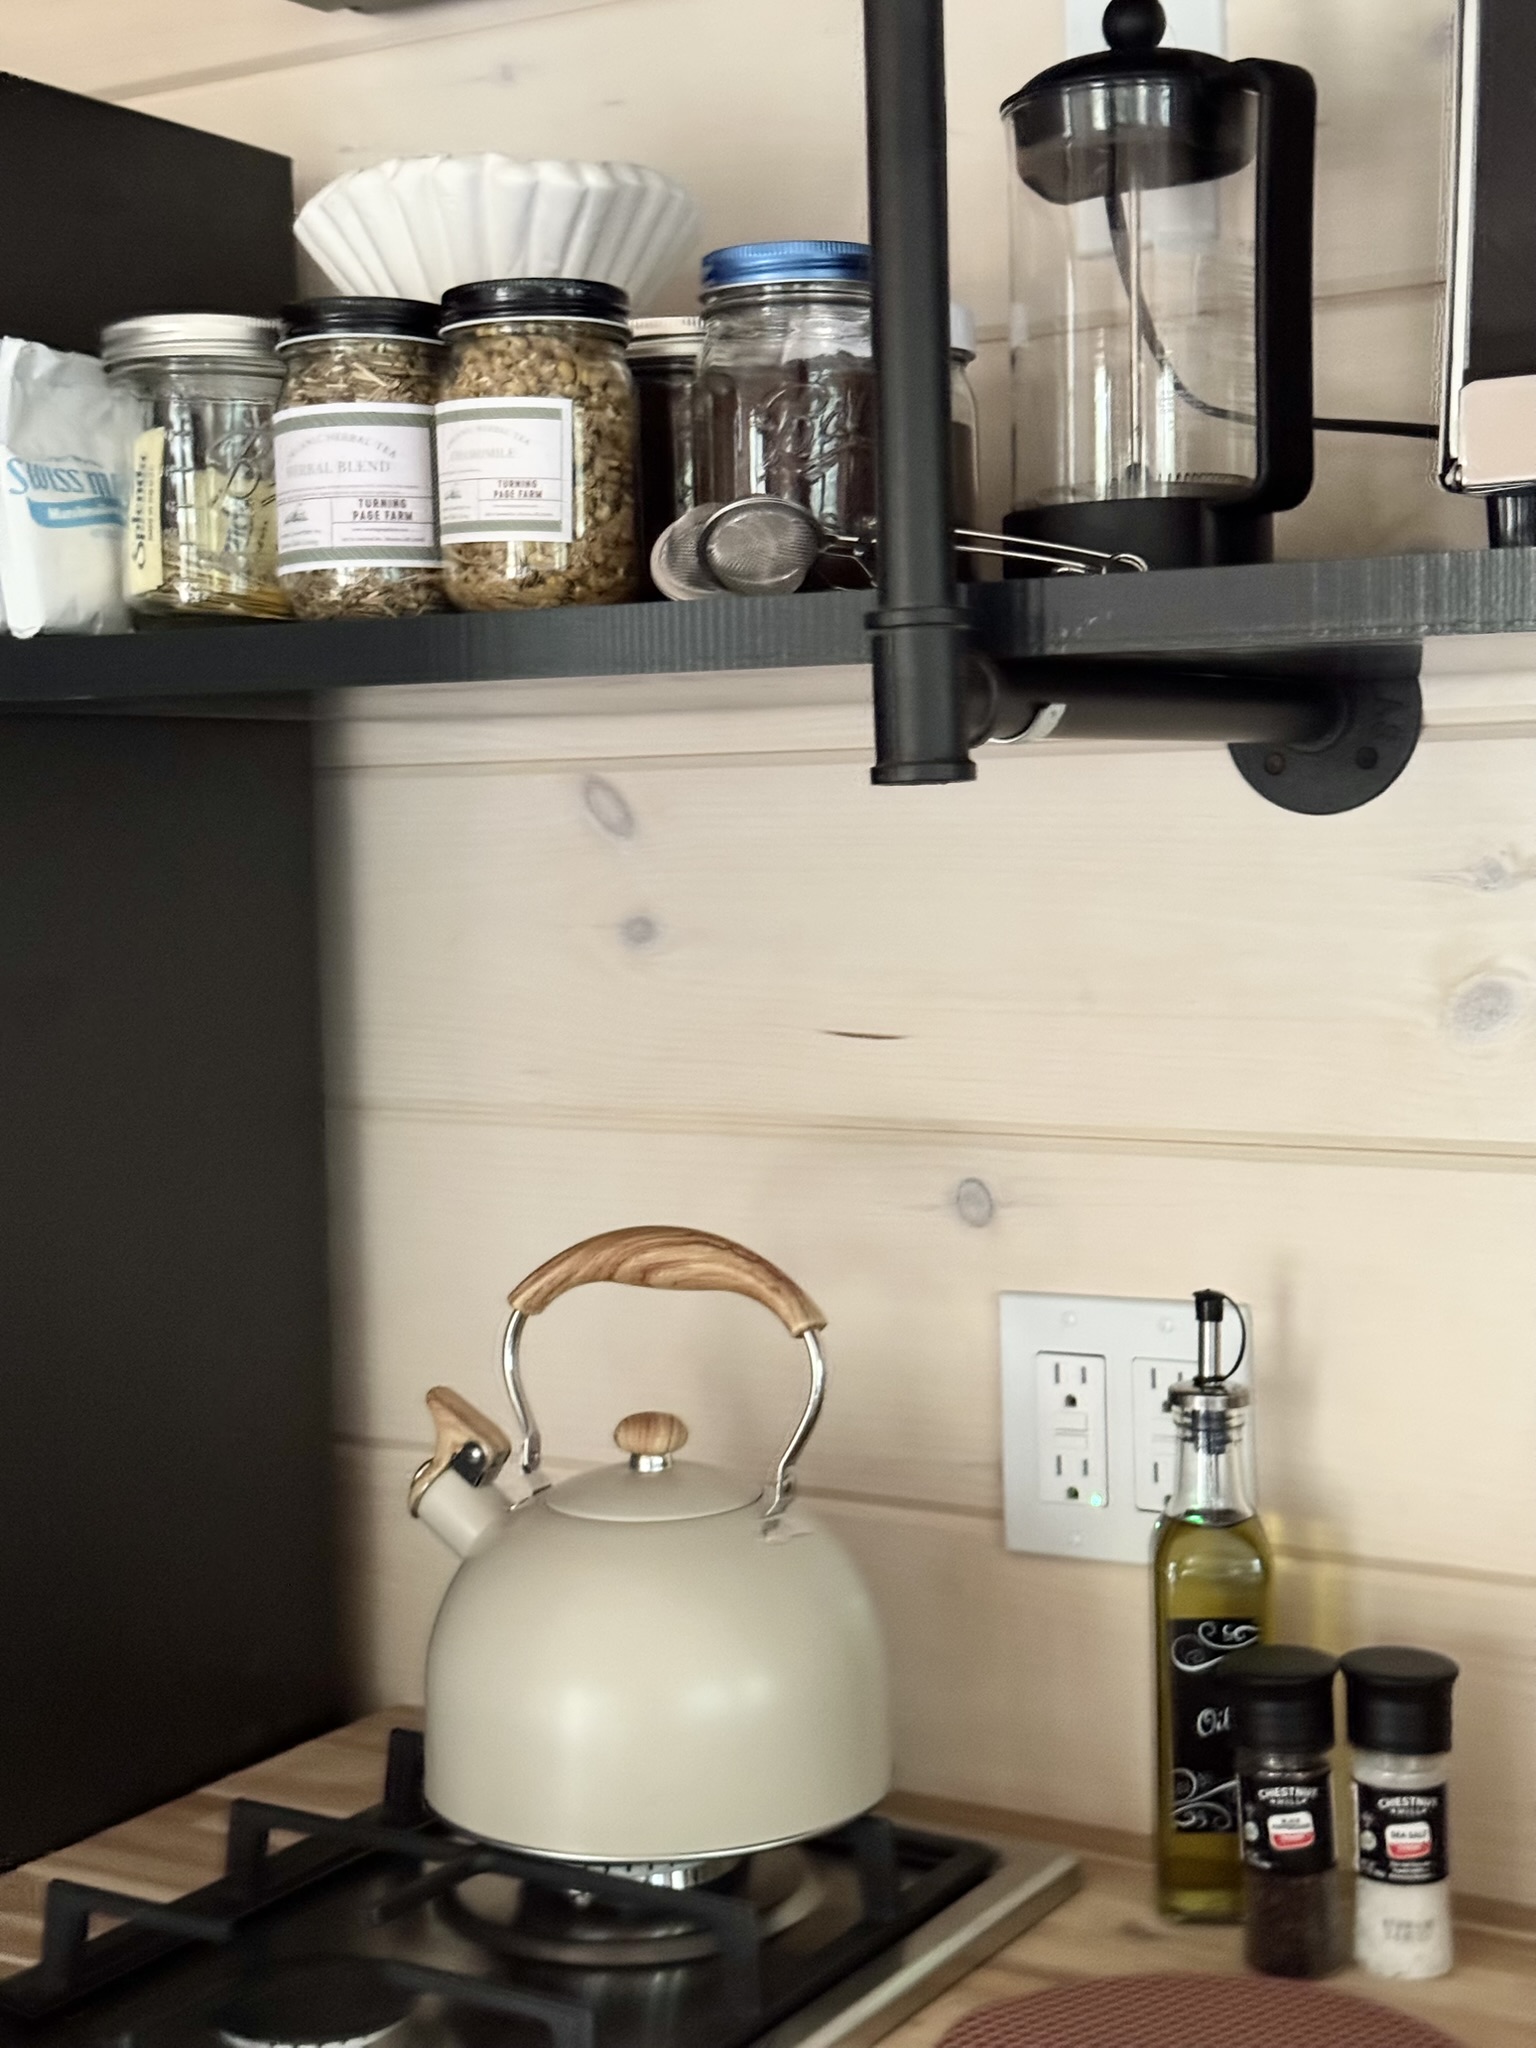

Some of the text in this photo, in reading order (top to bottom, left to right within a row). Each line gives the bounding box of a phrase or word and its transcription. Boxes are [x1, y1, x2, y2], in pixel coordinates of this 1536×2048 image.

[337, 460, 391, 474] BLEND
[7, 457, 85, 495] SWISS
[498, 480, 537, 489] TURNING
[493, 489, 543, 498] PAGE FARM
[358, 499, 408, 509] TURNING
[352, 510, 413, 521] PAGE FARM
[1197, 1706, 1230, 1737] Oil
